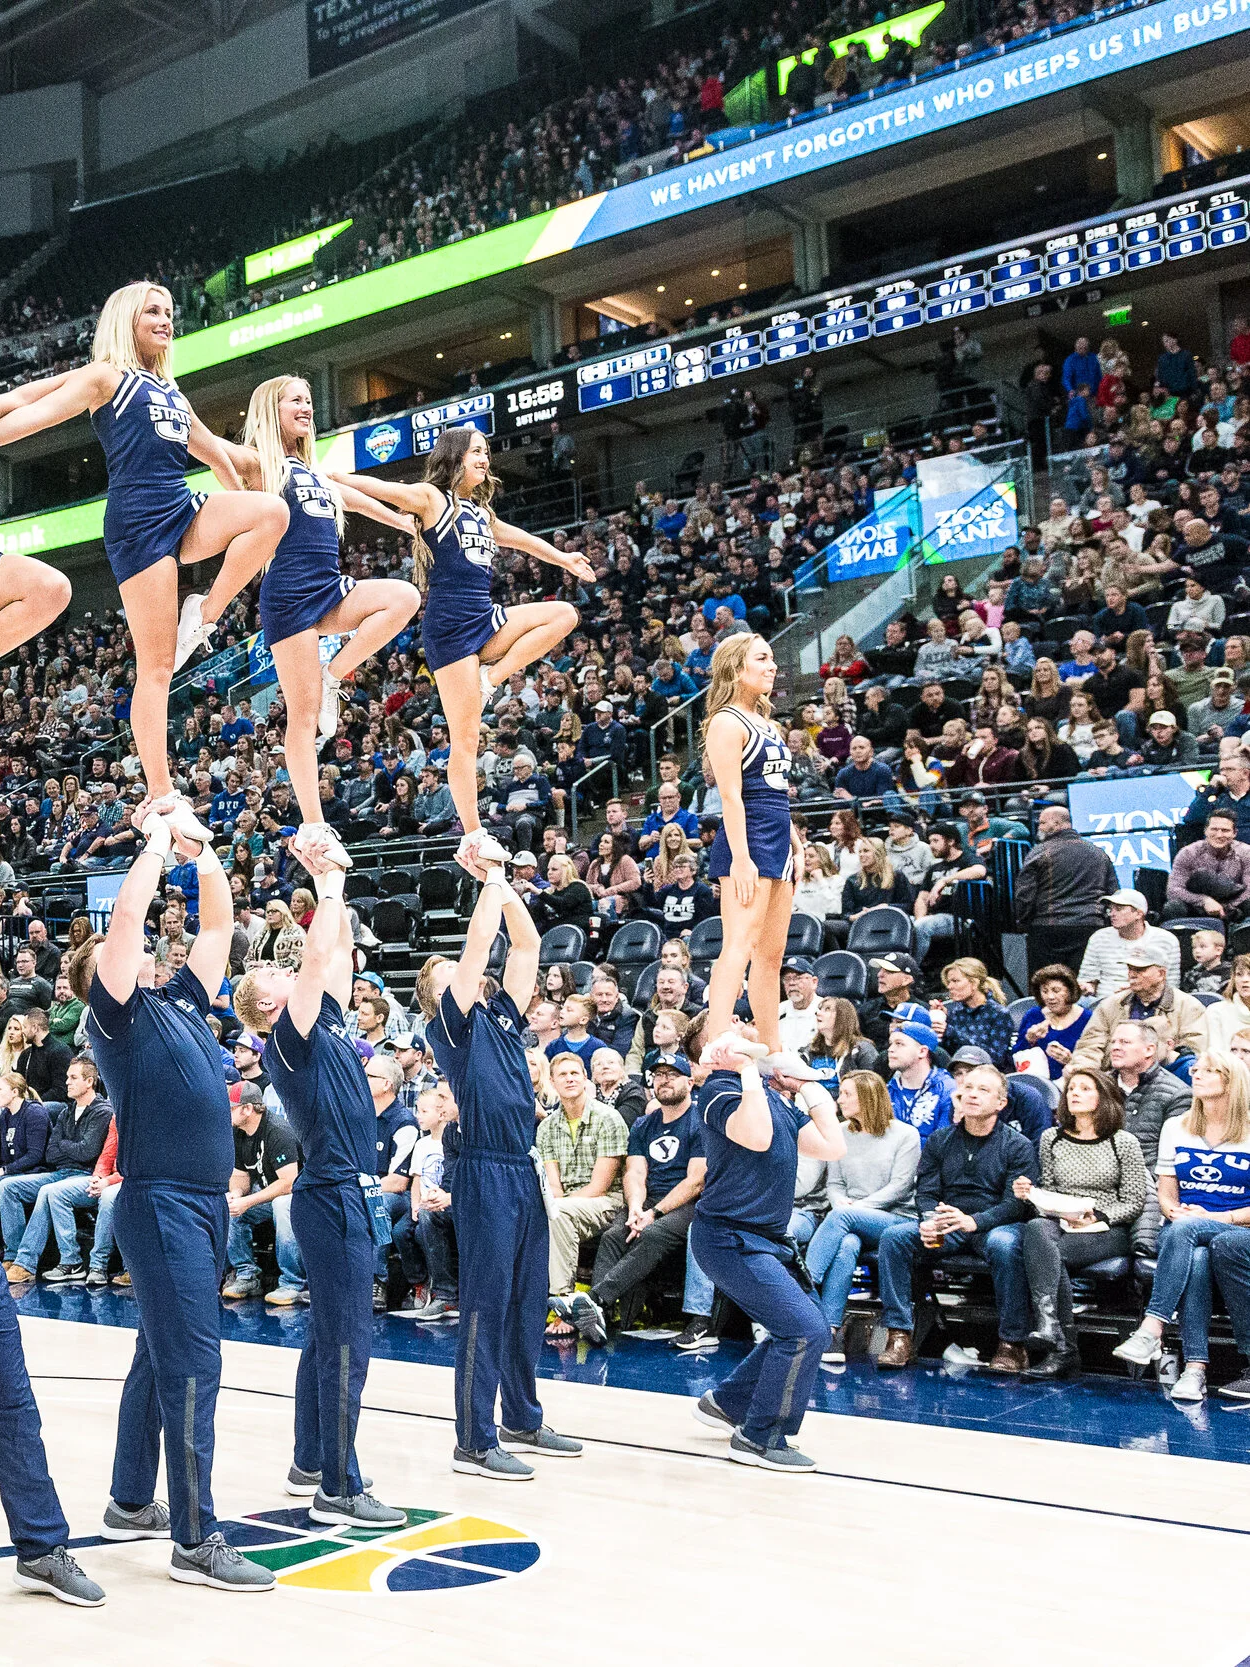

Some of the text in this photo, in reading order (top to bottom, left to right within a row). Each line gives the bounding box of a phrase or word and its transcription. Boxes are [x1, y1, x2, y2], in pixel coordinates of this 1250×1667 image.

[651, 182, 682, 207] WE
[688, 150, 776, 195] HAVEN'T
[783, 100, 925, 164] FORGOTTEN
[933, 79, 994, 113] WHO
[1003, 50, 1081, 90] KEEPS
[1088, 35, 1124, 61] US
[1133, 22, 1163, 47] IN
[1167, 200, 1199, 218] AST
[1210, 191, 1241, 207] STL
[507, 380, 564, 413] 15:56
[599, 383, 613, 402] 4
[295, 487, 336, 505] STAT
[762, 760, 792, 776] STA
[1094, 835, 1172, 867] BAN
[663, 903, 695, 913] STATE
